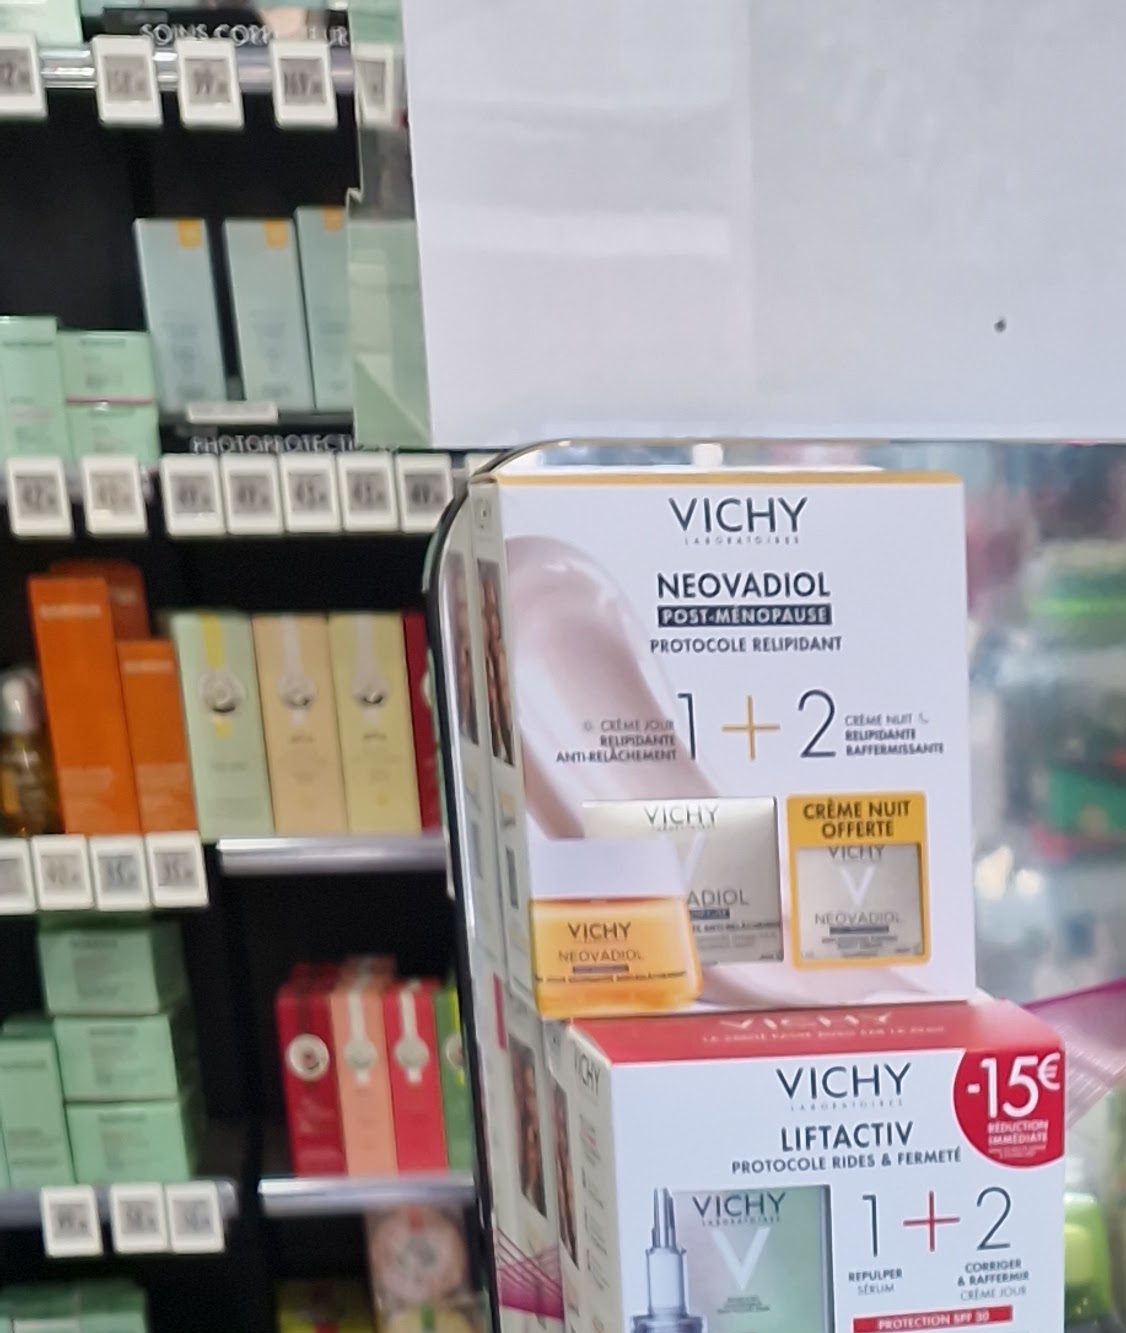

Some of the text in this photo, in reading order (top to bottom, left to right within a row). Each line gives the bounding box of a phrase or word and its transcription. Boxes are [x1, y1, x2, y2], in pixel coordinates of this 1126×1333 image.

[668, 497, 808, 533] VICHY
[657, 572, 831, 599] NEOVADIOL
[661, 605, 828, 625] POST-MÉNOPAUSE
[650, 635, 842, 654] PROTOCOLE RELIPIDANT
[677, 693, 696, 761] 1
[797, 689, 838, 760] 2
[644, 803, 720, 827] VICHY
[802, 797, 912, 822] CRÈME NUIT
[821, 818, 895, 840] OFFERTE
[686, 889, 748, 907] ADIOL
[567, 921, 632, 941] VICHY
[557, 948, 643, 962] NEOVADIOL
[775, 1063, 912, 1101] VICHY
[781, 1121, 914, 1152] LIFTACTIV
[731, 1156, 827, 1175] PROTOCOLE
[832, 1153, 876, 1170] RIDES
[897, 1145, 962, 1166] FERMETÉ
[692, 1191, 787, 1219] VICHY
[861, 1193, 878, 1259] 1
[975, 1185, 1013, 1252] 2
[848, 1267, 903, 1283] REPULPER
[964, 1258, 1022, 1275] CORRIGER
[968, 1270, 1031, 1287] RAFFERMIR
[877, 1312, 951, 1331] PROTECTION
